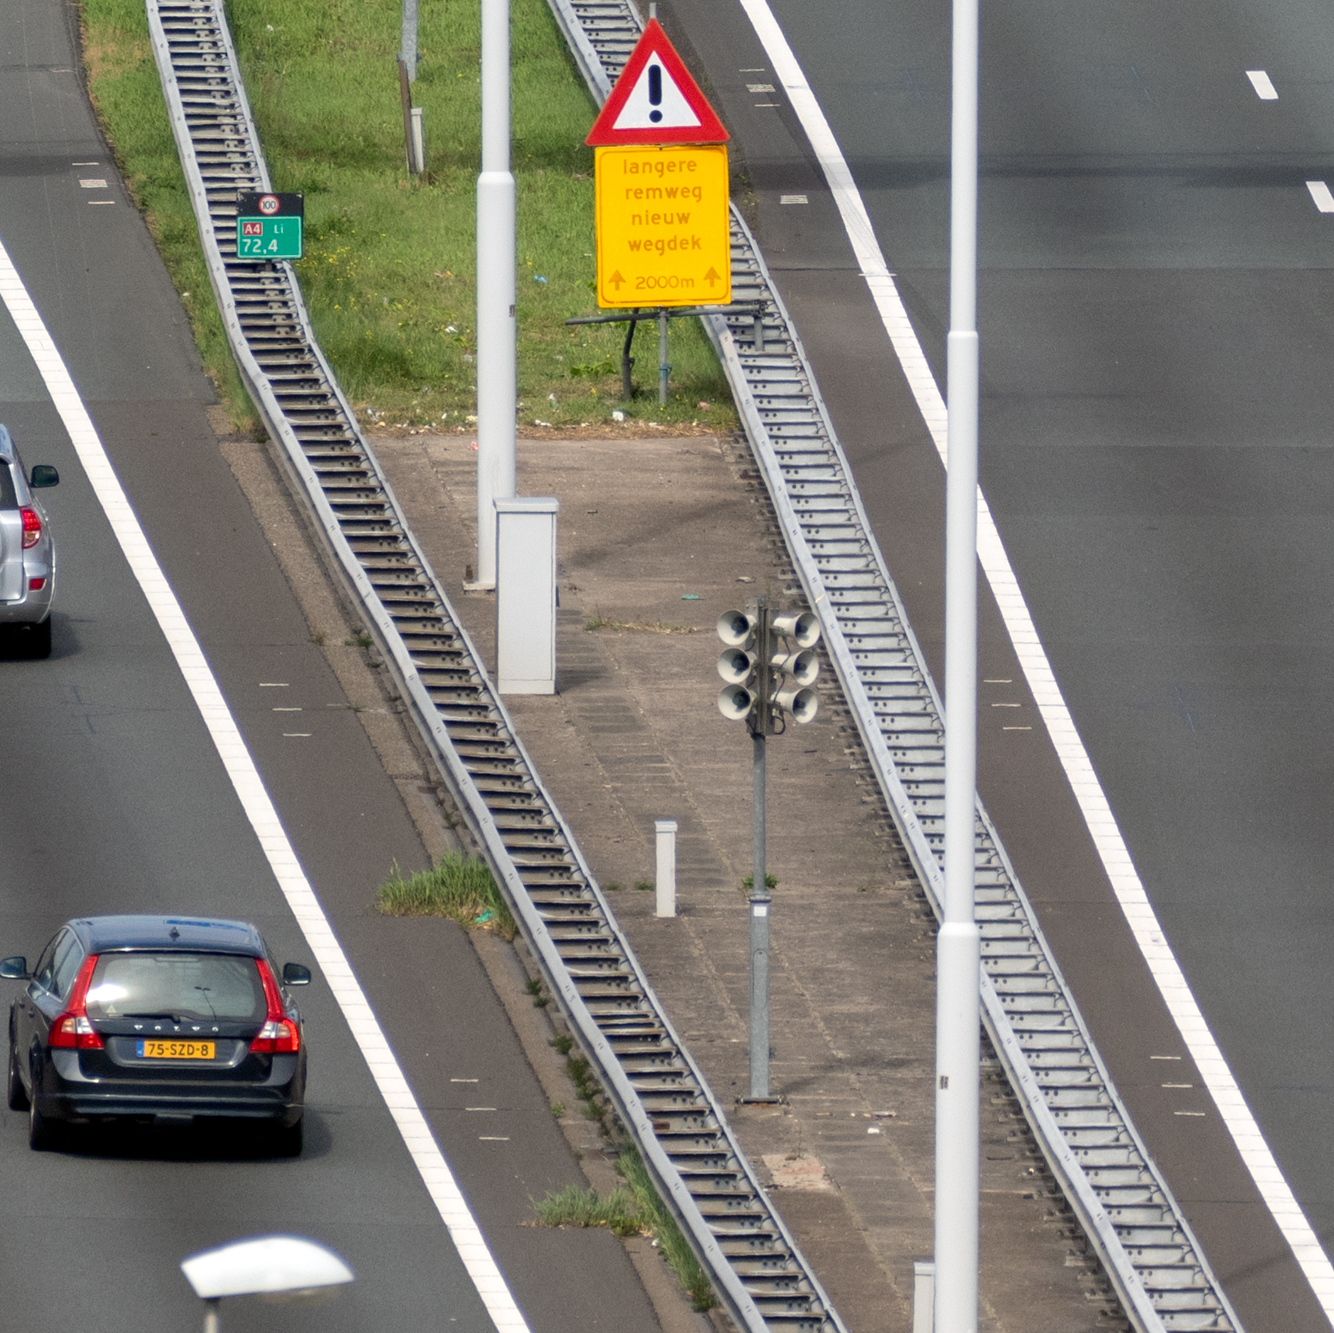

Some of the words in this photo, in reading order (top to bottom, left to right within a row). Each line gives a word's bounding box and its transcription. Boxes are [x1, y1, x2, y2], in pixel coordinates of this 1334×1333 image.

[623, 158, 698, 178] langere
[625, 185, 703, 204] remweg
[631, 209, 691, 226] nieuw
[244, 223, 261, 235] A4
[274, 223, 284, 234] Li
[242, 239, 278, 255] 72,4
[627, 234, 702, 257] wegdek
[148, 1043, 209, 1057] 75-SZD-8
